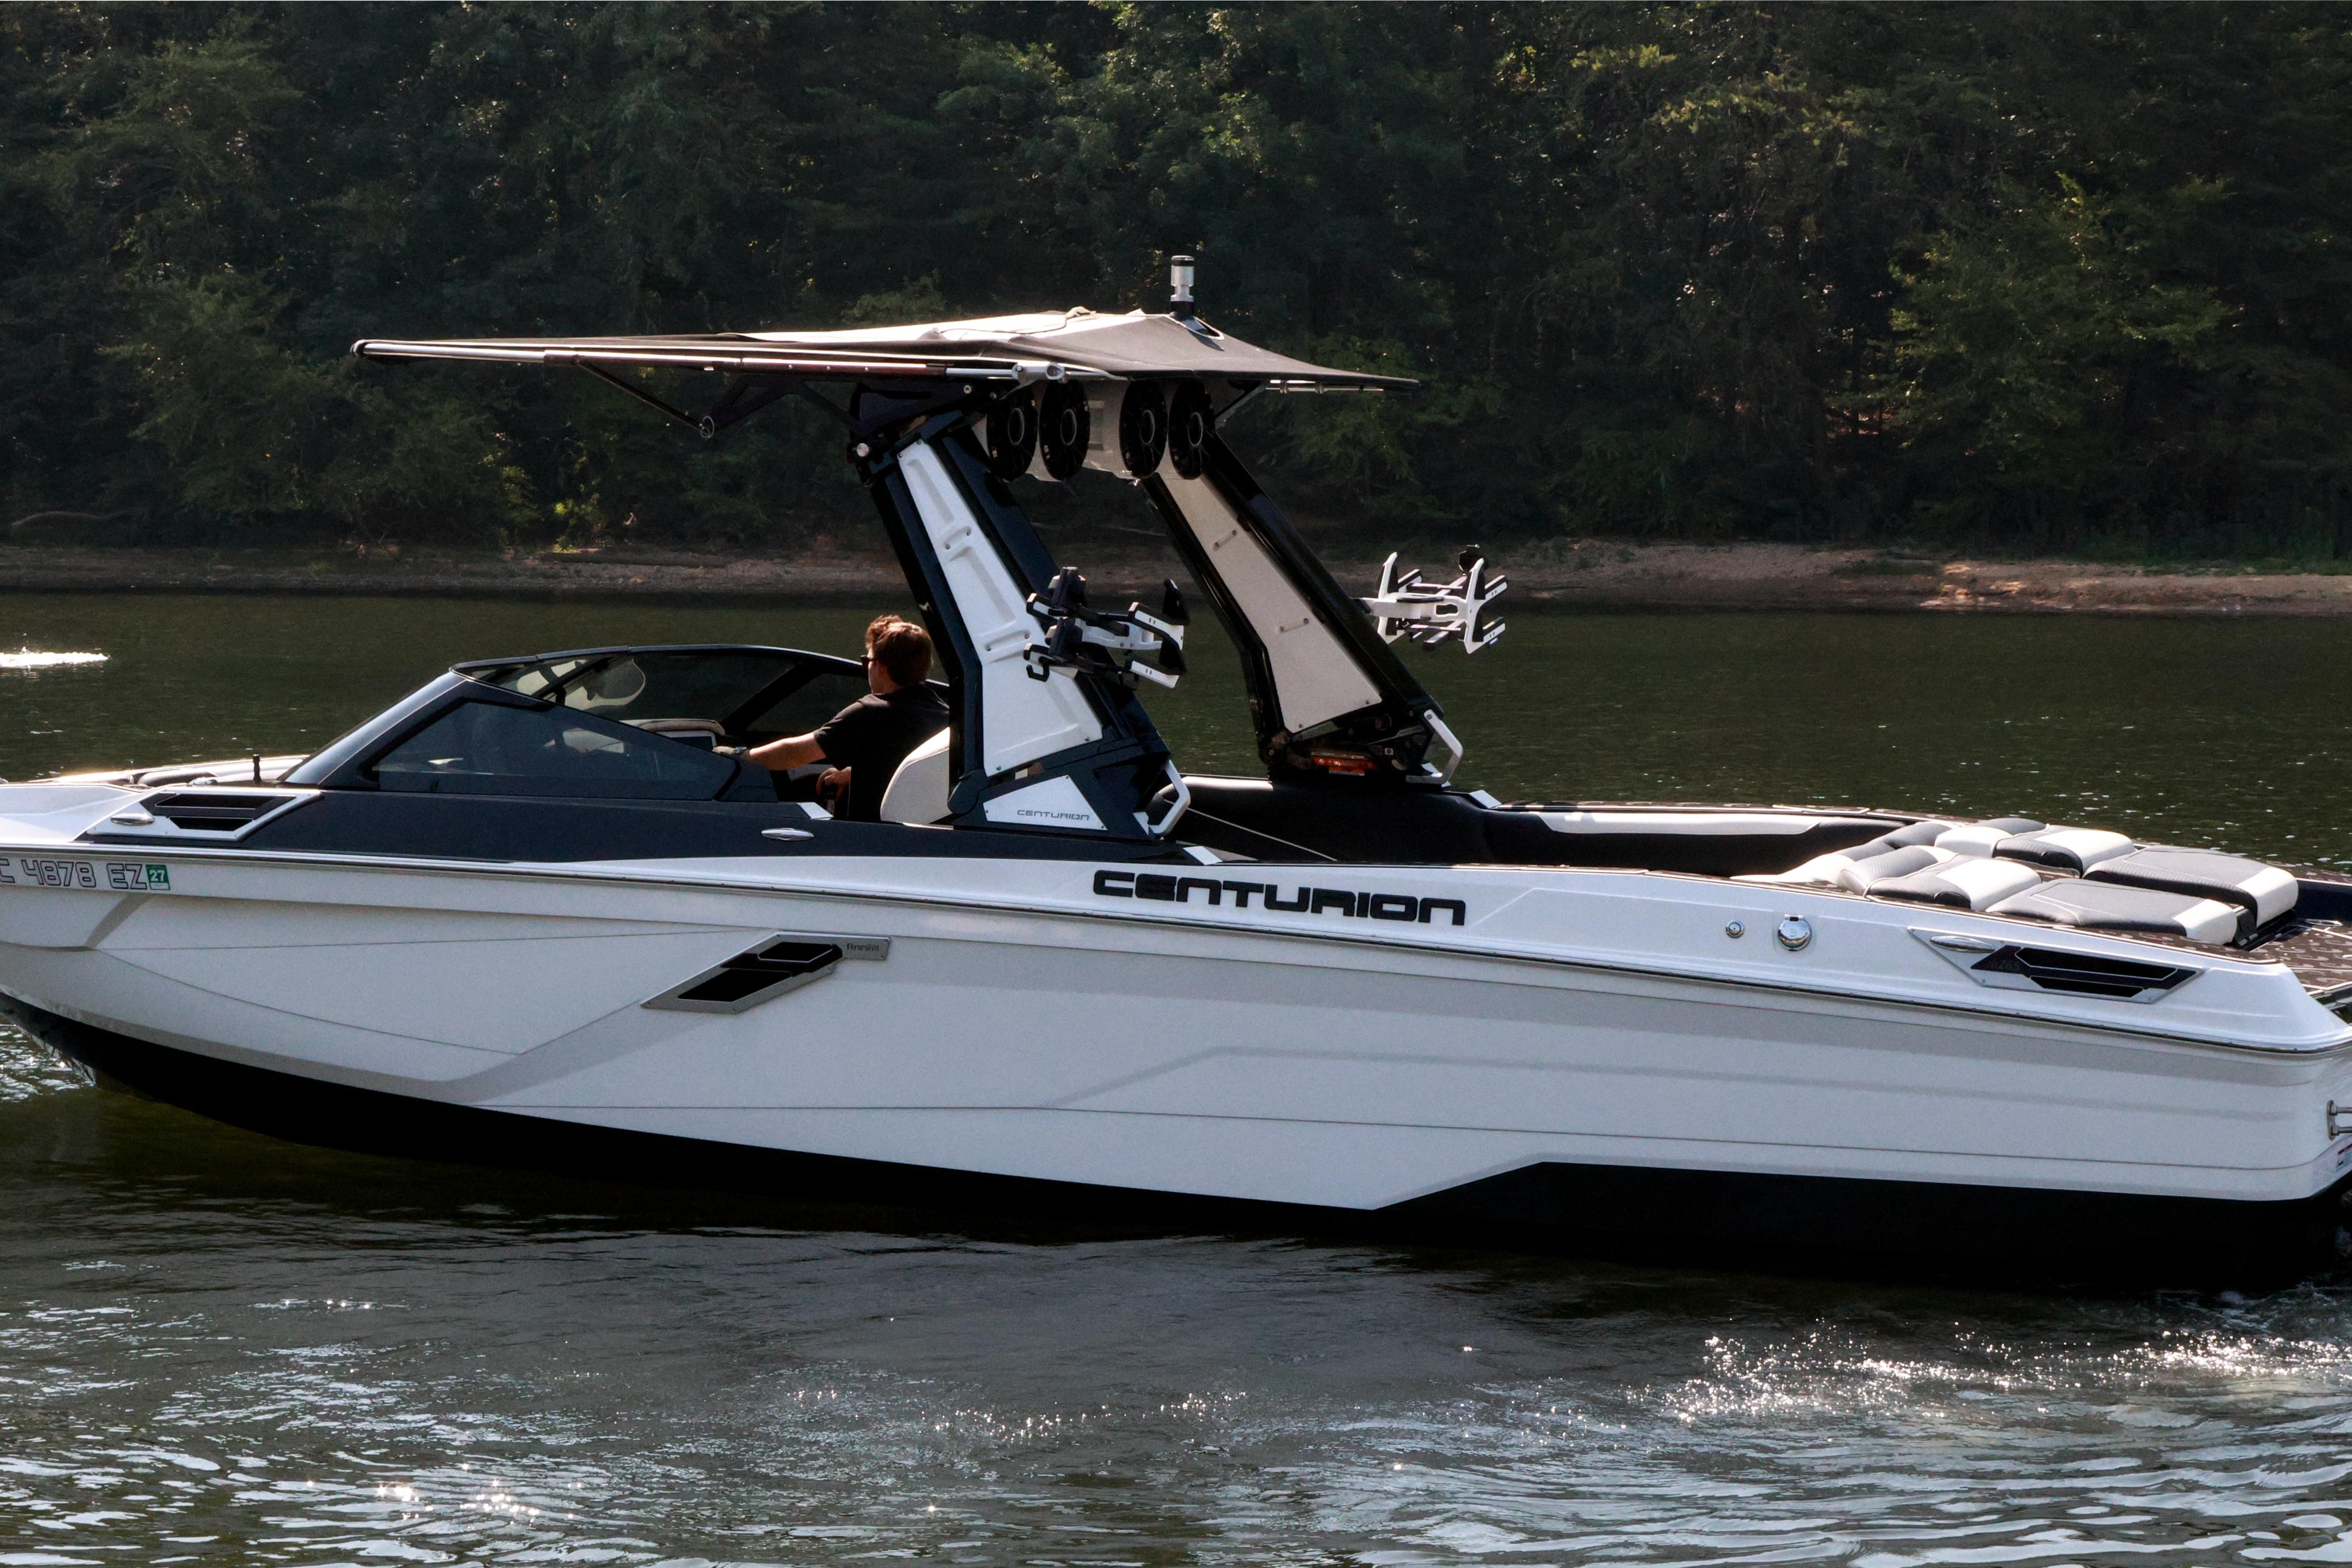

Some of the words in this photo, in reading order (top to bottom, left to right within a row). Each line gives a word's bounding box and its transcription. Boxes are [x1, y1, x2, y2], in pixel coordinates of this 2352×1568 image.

[1017, 809, 1089, 821] CENTURION
[21, 860, 96, 887] 4878
[106, 863, 148, 890] EZ
[149, 869, 165, 882] 27
[1093, 870, 1466, 926] CENTURION
